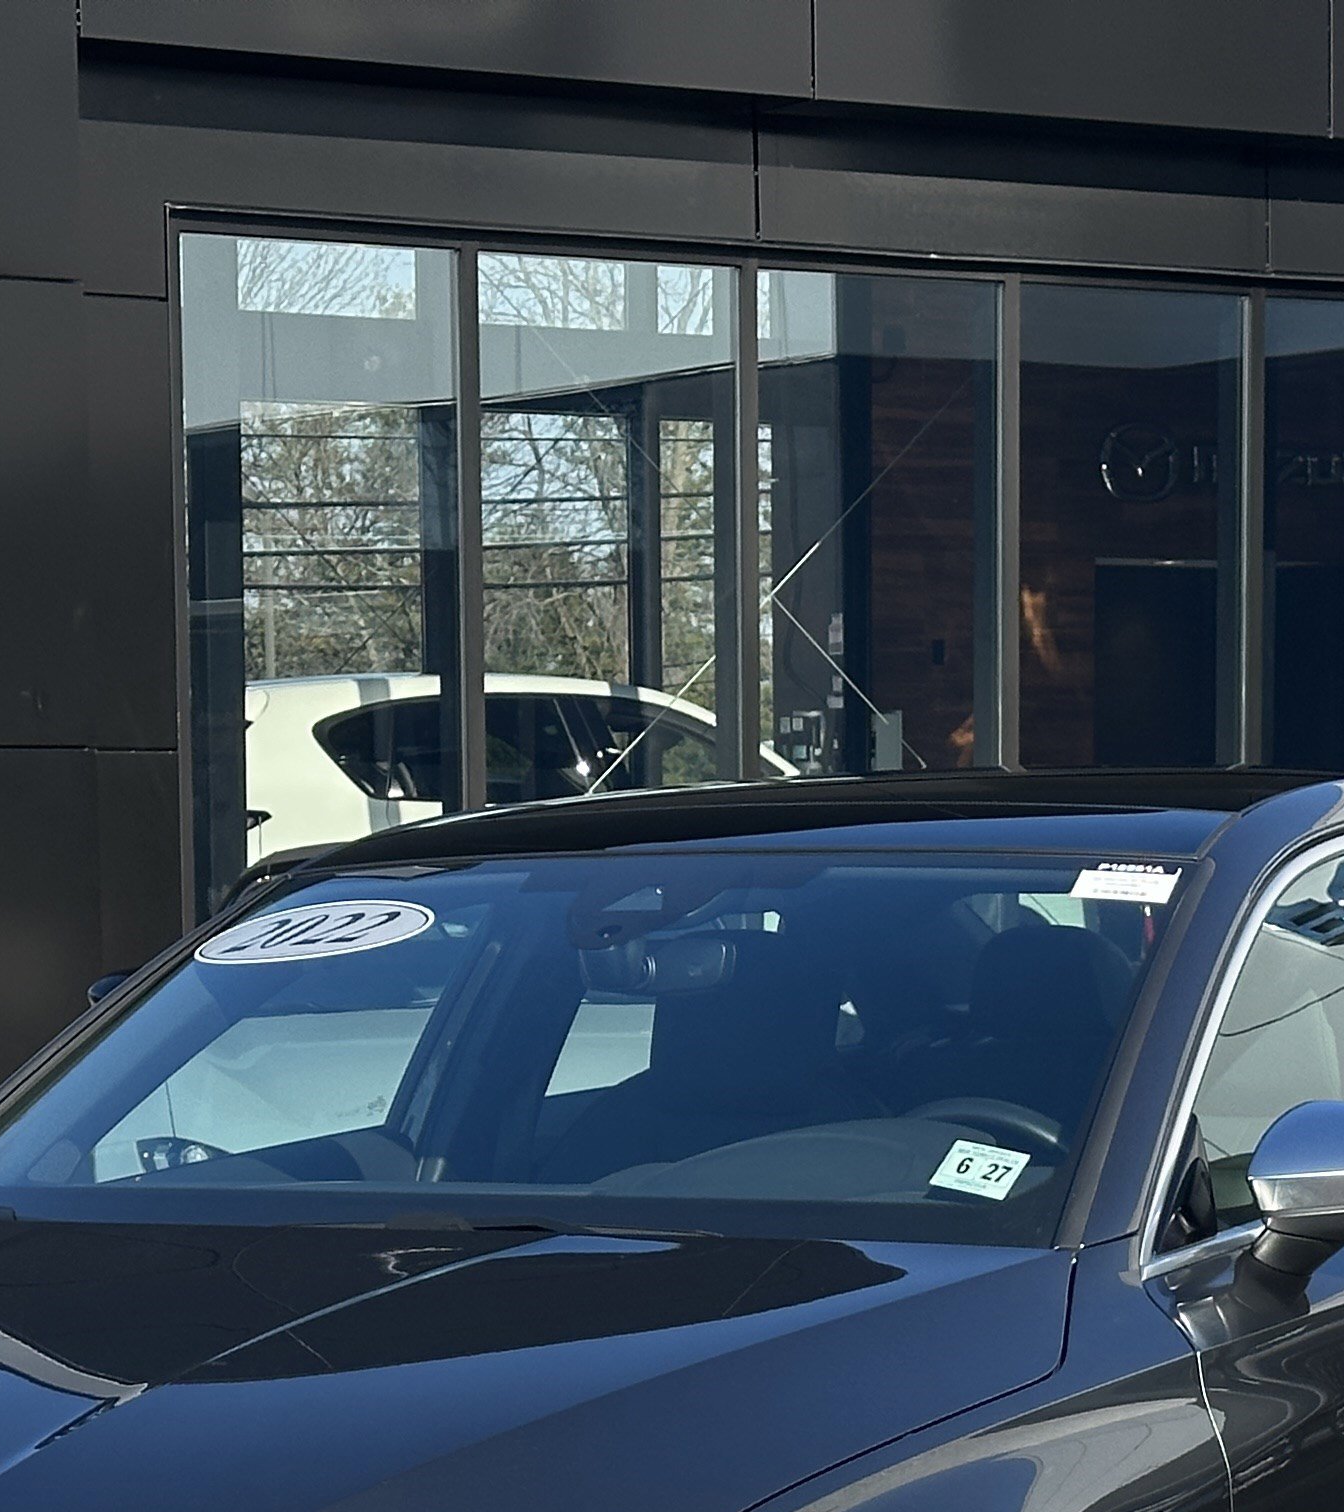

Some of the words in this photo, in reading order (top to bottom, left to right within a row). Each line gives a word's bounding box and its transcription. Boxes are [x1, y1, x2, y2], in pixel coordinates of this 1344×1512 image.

[218, 910, 402, 955] 2022
[956, 1157, 975, 1175] 6
[980, 1162, 1014, 1183] 27
